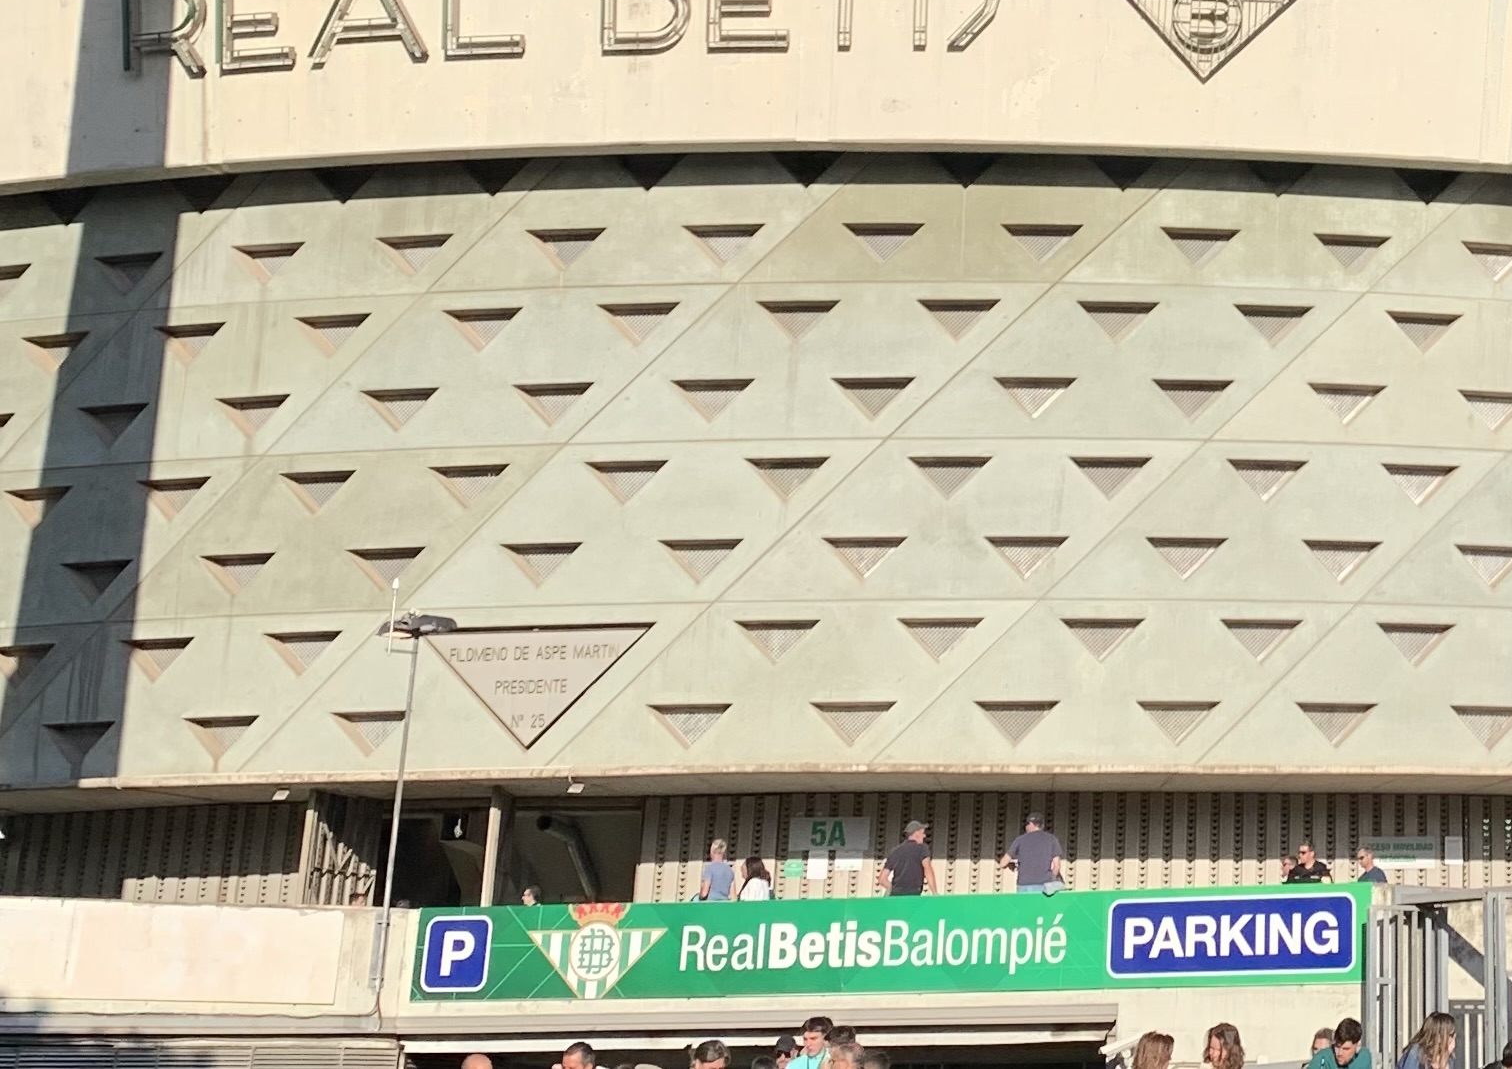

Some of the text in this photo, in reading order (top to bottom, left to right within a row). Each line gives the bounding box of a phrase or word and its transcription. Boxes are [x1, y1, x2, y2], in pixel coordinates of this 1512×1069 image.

[450, 646, 508, 662] FILOMENO
[513, 646, 530, 661] DE
[536, 645, 567, 660] ASPE
[494, 679, 567, 695] PRESIDENTE
[531, 713, 545, 729] 25
[811, 820, 846, 847] 5A
[1123, 911, 1340, 960] PARKING
[439, 930, 475, 977] P
